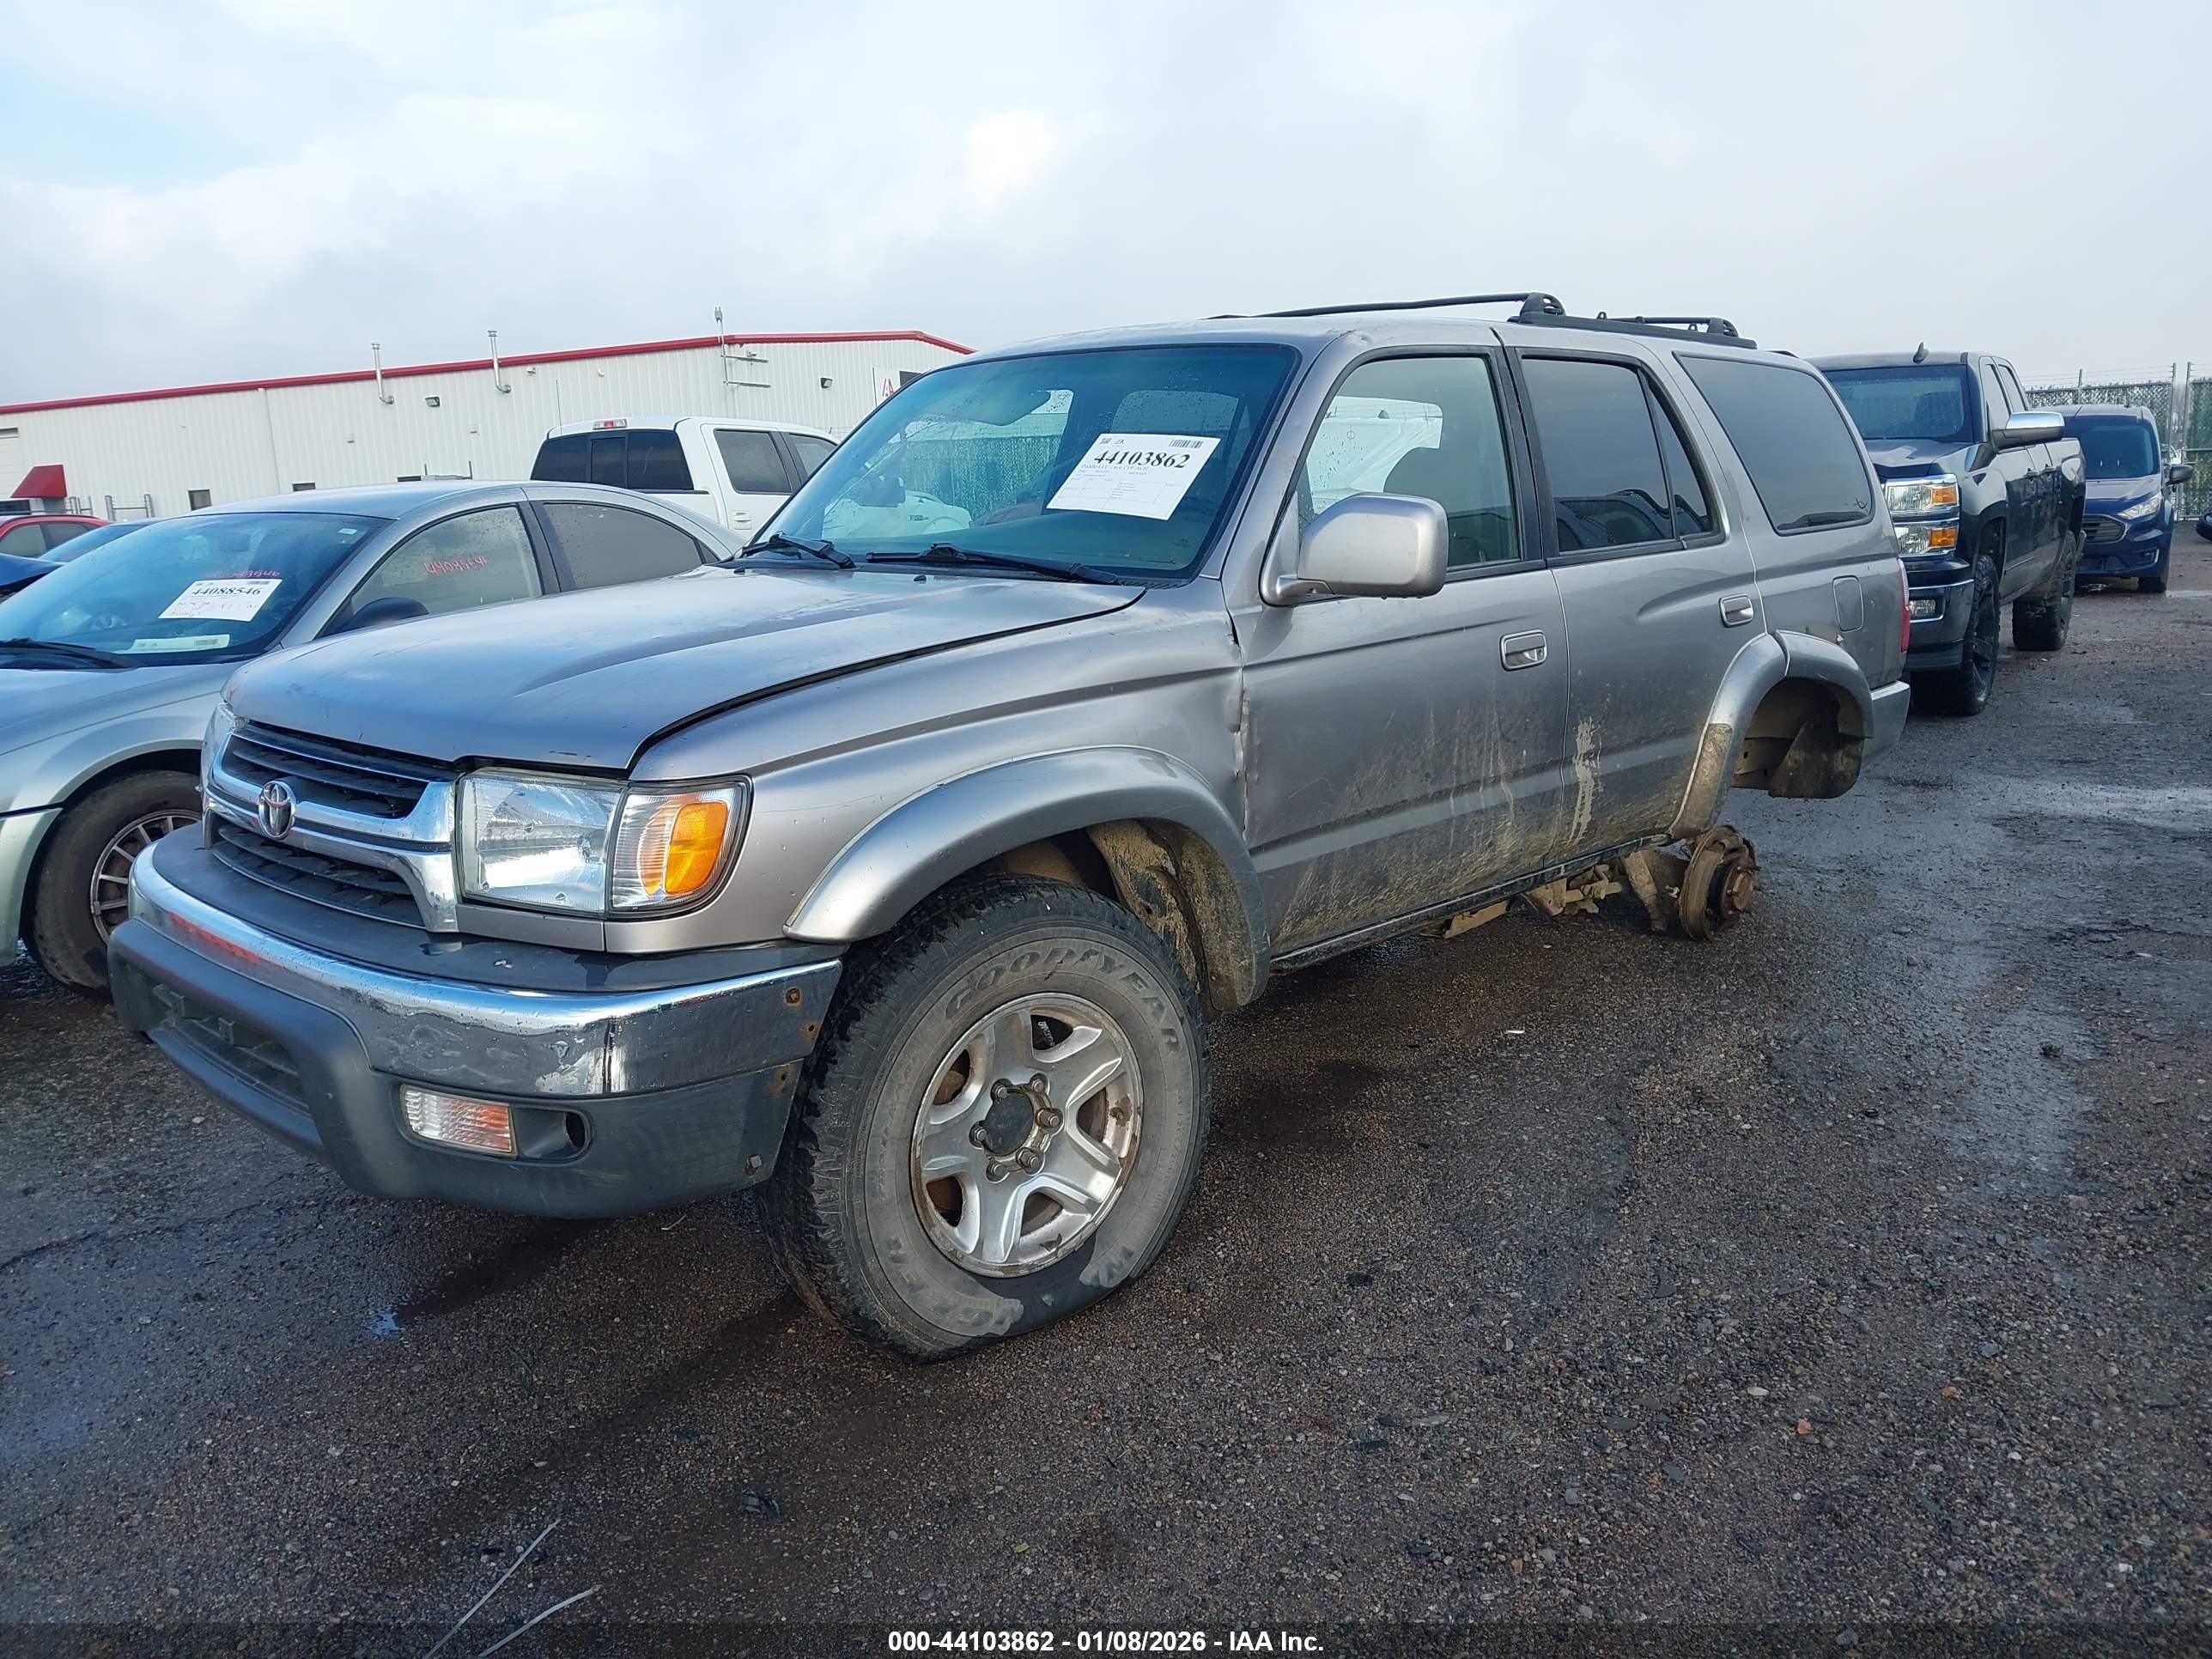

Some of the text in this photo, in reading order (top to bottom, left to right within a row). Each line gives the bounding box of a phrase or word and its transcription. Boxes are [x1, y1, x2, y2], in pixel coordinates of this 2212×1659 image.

[1093, 450, 1191, 469] 44103862
[191, 586, 262, 595] 44088546
[945, 946, 1179, 1053] GOODYEAR
